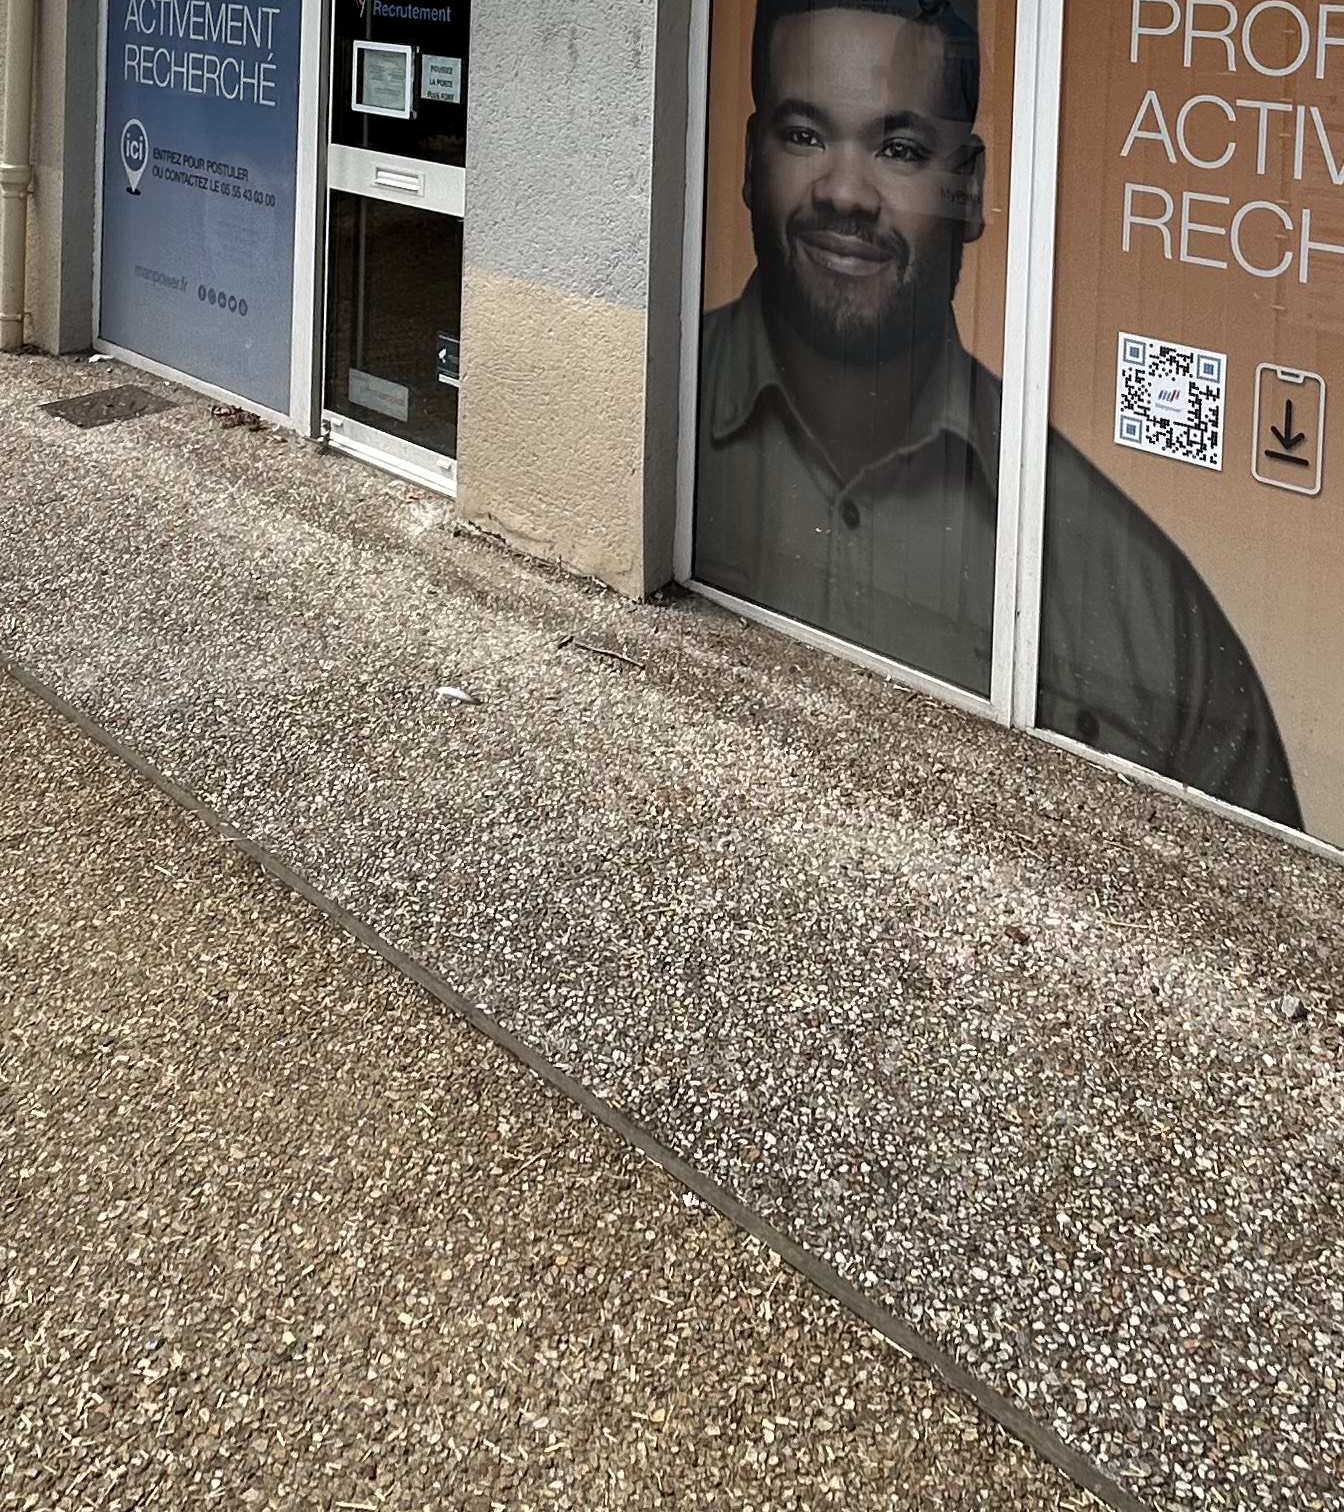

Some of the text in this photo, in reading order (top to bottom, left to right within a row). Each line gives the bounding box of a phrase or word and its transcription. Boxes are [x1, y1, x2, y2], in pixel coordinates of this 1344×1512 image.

[373, 0, 452, 22] Recrutement
[124, 43, 277, 107] RECHERCHÉ
[126, 133, 143, 160] ici
[153, 147, 249, 182] ENTREZ POUR POSTULER
[152, 165, 163, 180] OU
[165, 169, 209, 191] CONTACTEZ
[209, 179, 219, 193] LE
